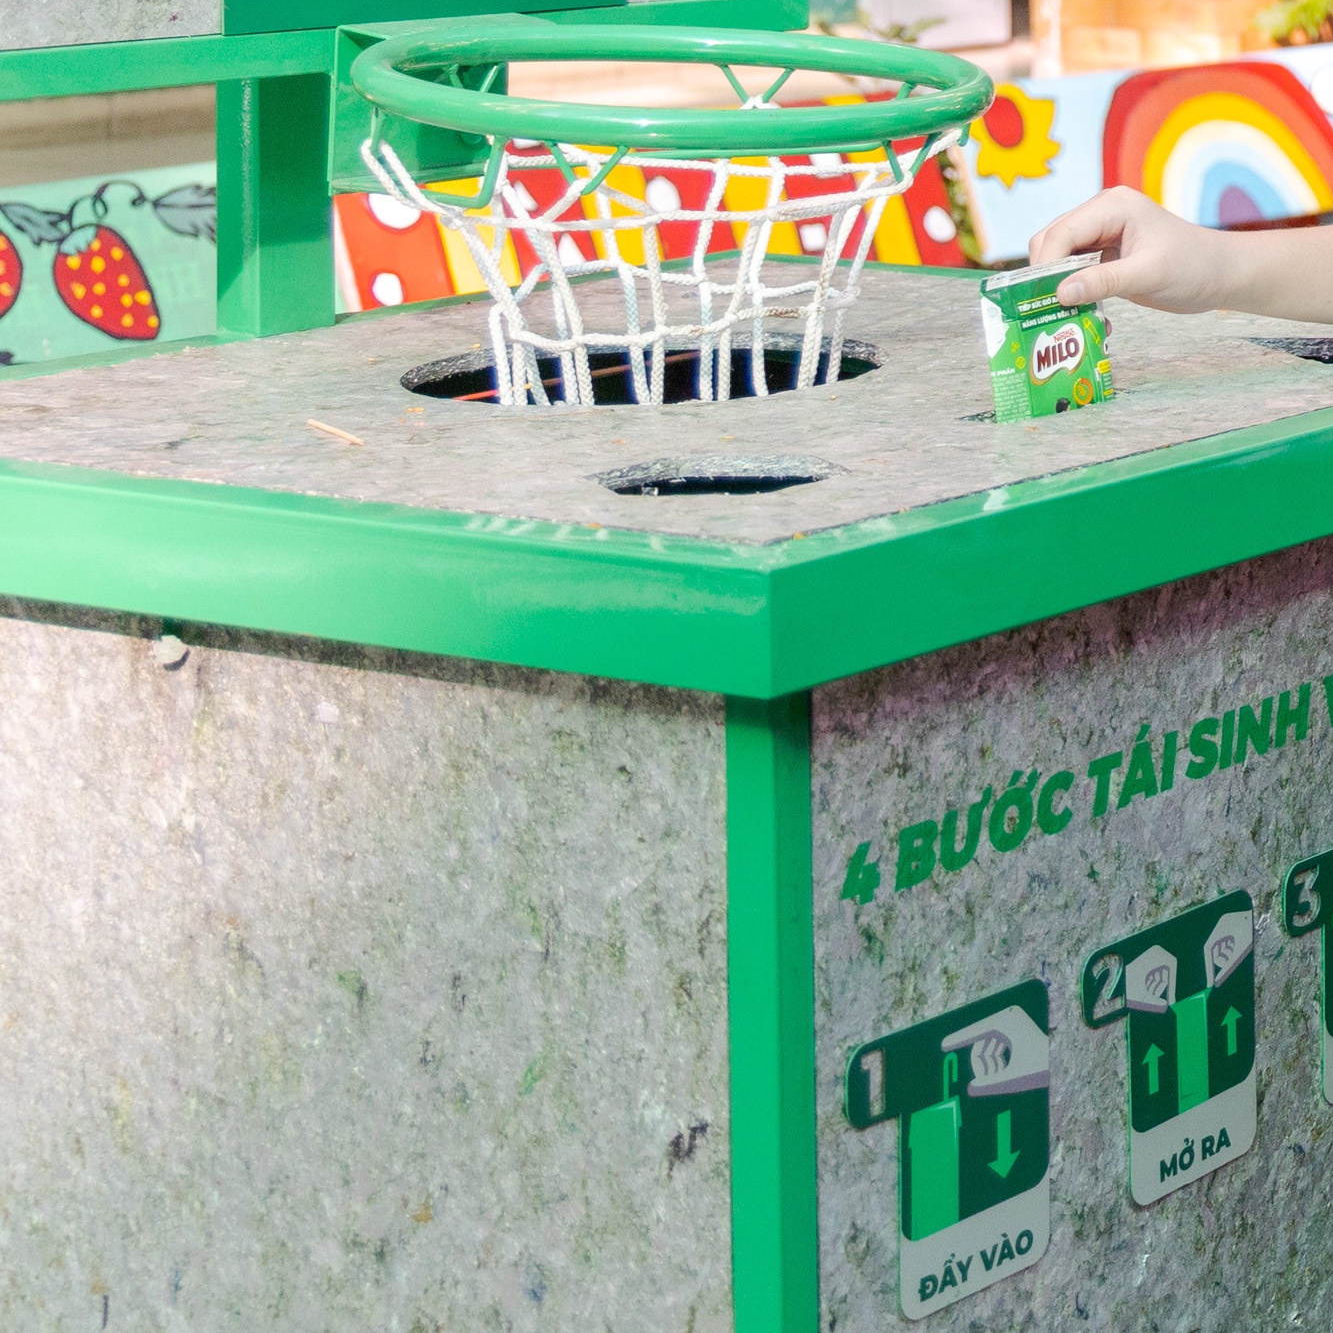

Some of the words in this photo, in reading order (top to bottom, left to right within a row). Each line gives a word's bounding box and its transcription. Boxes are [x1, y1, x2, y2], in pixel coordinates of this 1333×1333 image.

[1036, 337, 1080, 373] MILO
[840, 840, 881, 905] 4
[895, 769, 1075, 893] BƯỚC
[1087, 724, 1178, 817] TÁI
[1184, 682, 1312, 779] SINH
[1292, 864, 1321, 928] 3
[1092, 952, 1125, 1020] 2
[861, 1048, 885, 1116] 1
[1159, 1137, 1195, 1183] MỞ
[1201, 1127, 1232, 1161] RA
[918, 1253, 973, 1302] ĐẨY
[979, 1229, 1034, 1272] VÀO
